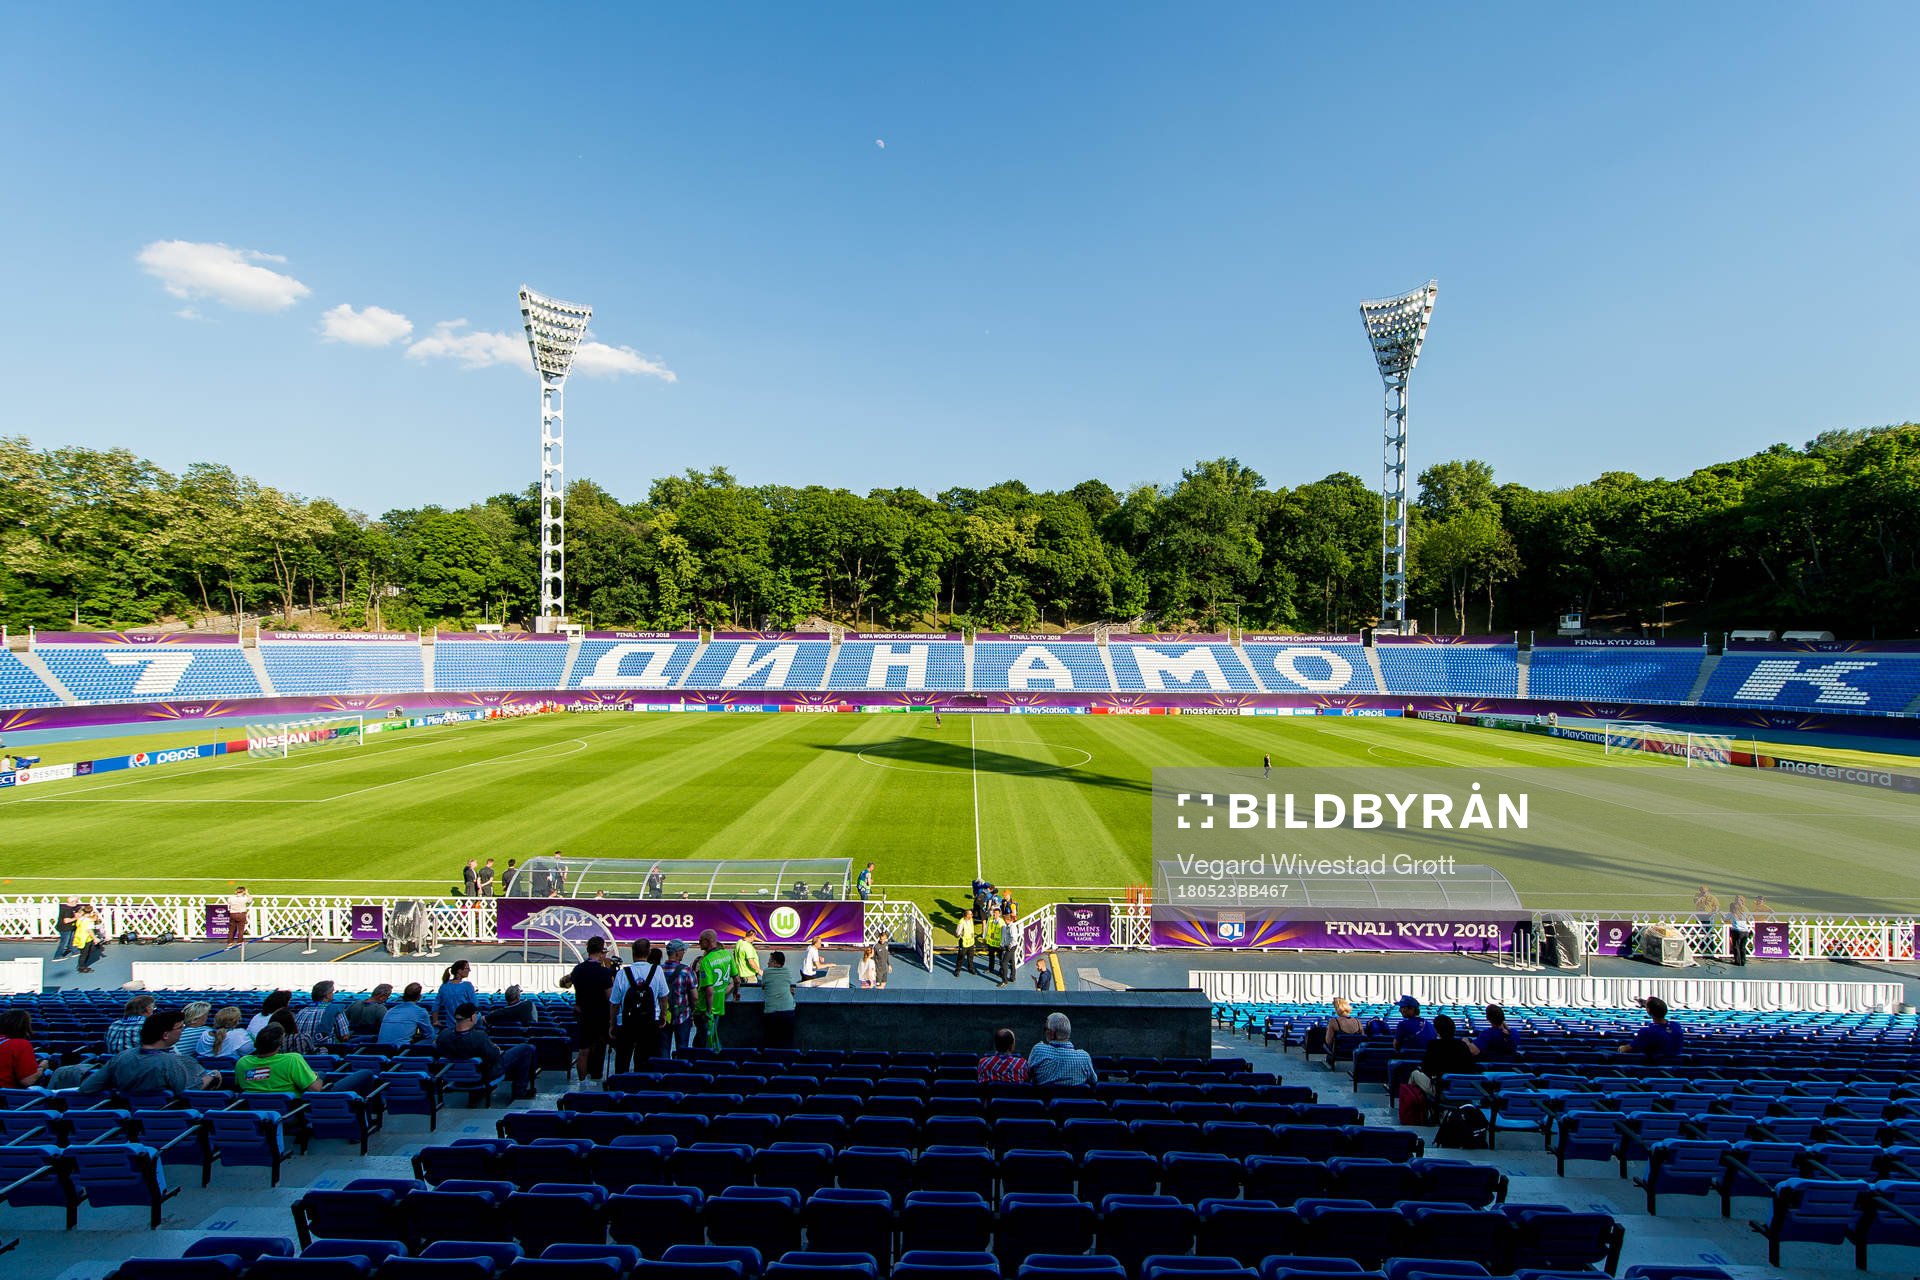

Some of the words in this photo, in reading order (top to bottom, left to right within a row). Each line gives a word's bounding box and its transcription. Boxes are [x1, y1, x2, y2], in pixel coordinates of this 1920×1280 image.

[738, 704, 764, 713] pepsi
[794, 705, 838, 713] NISSAN
[1024, 706, 1070, 715] PlayStation
[1116, 707, 1150, 716] UniCredit
[1183, 707, 1238, 715] mastercard
[1357, 708, 1387, 717] pepsi
[1417, 711, 1456, 724] NISSAN
[249, 731, 310, 750] NISSAN
[157, 745, 200, 764] pepsi
[1779, 759, 1892, 787] mastercard
[527, 912, 592, 927] FINAL
[596, 912, 647, 928] KYIV
[651, 913, 694, 928] 2018
[1325, 920, 1392, 936] FINAL
[1396, 921, 1450, 937] KYIV
[1453, 923, 1499, 938] 2018
[713, 964, 731, 987] 24
